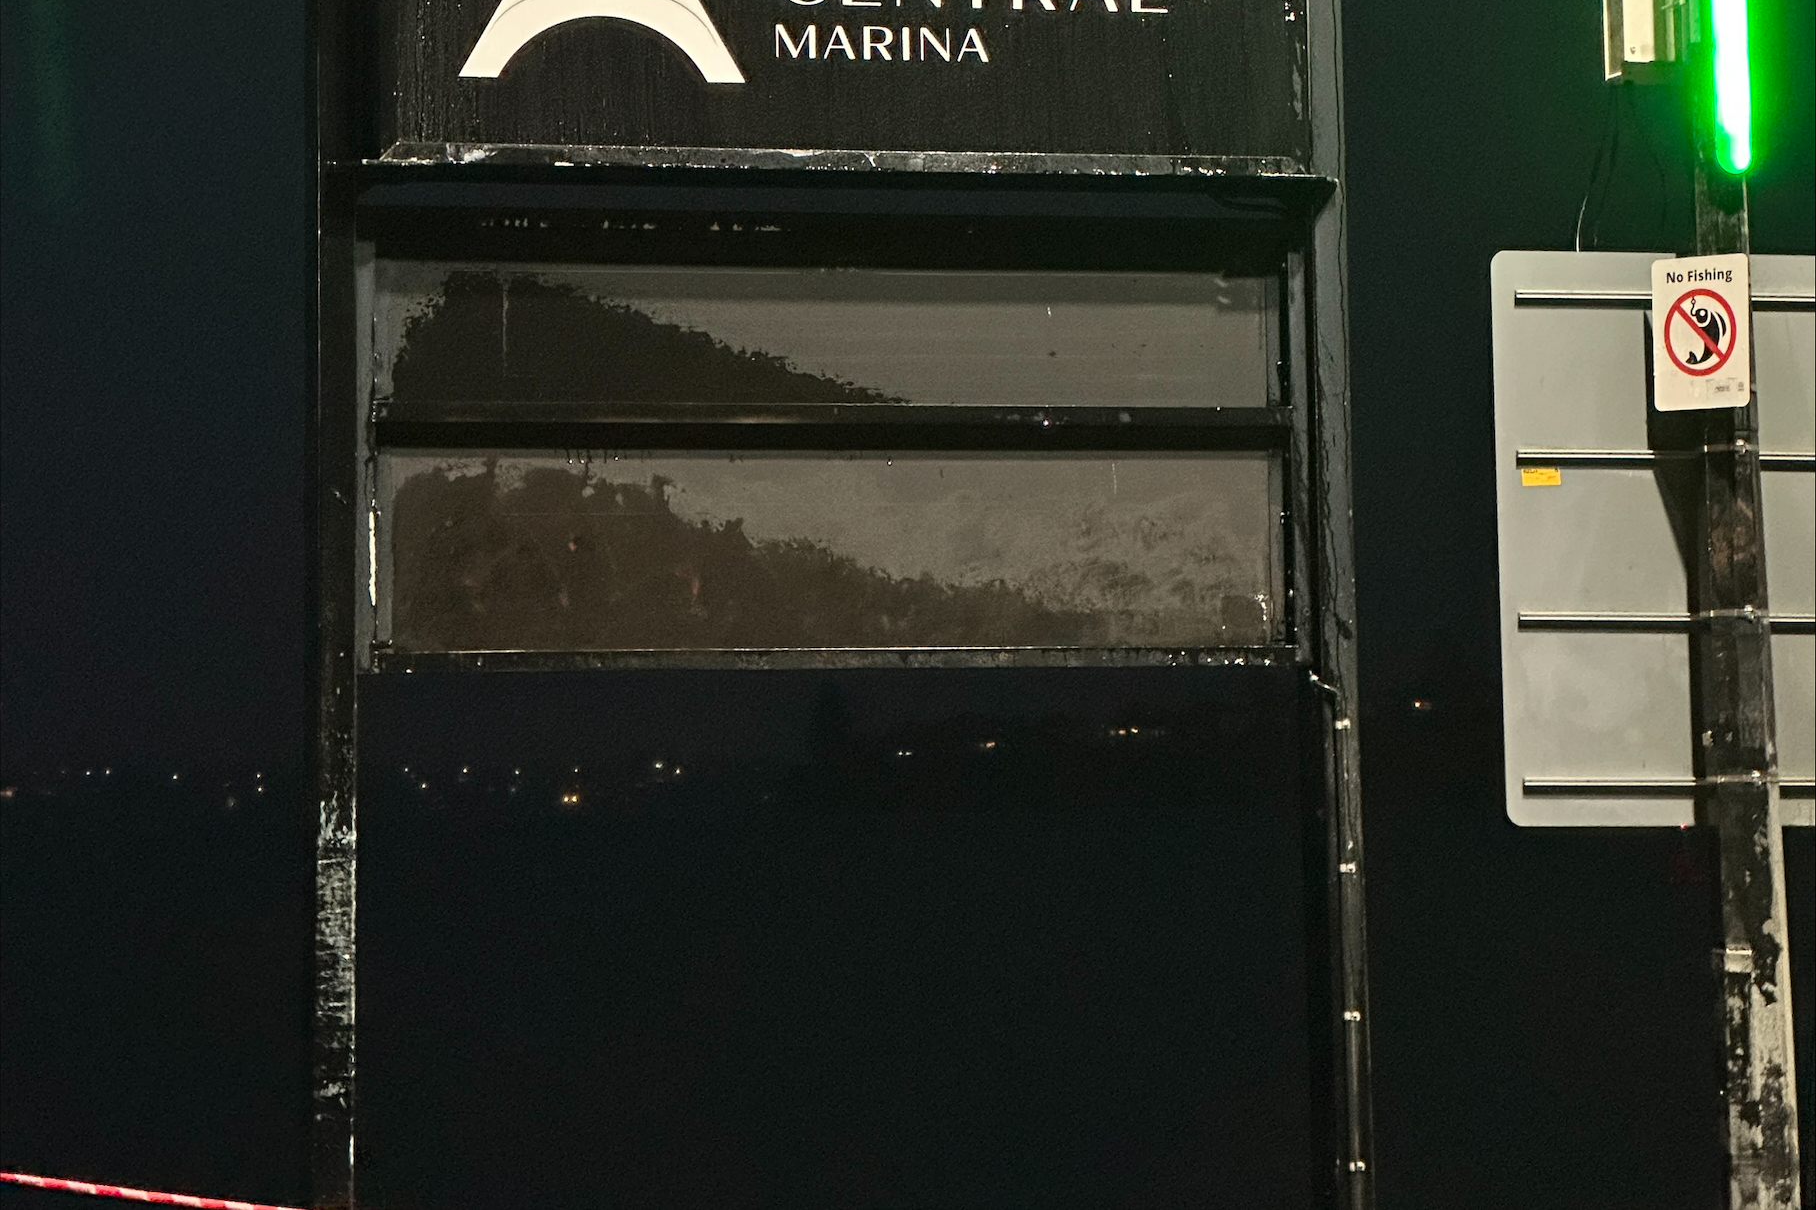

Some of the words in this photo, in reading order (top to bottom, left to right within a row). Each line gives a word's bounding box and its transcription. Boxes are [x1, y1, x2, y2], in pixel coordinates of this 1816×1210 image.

[774, 23, 990, 63] MARINA
[1666, 272, 1684, 284] No
[1687, 268, 1733, 283] Fishing
